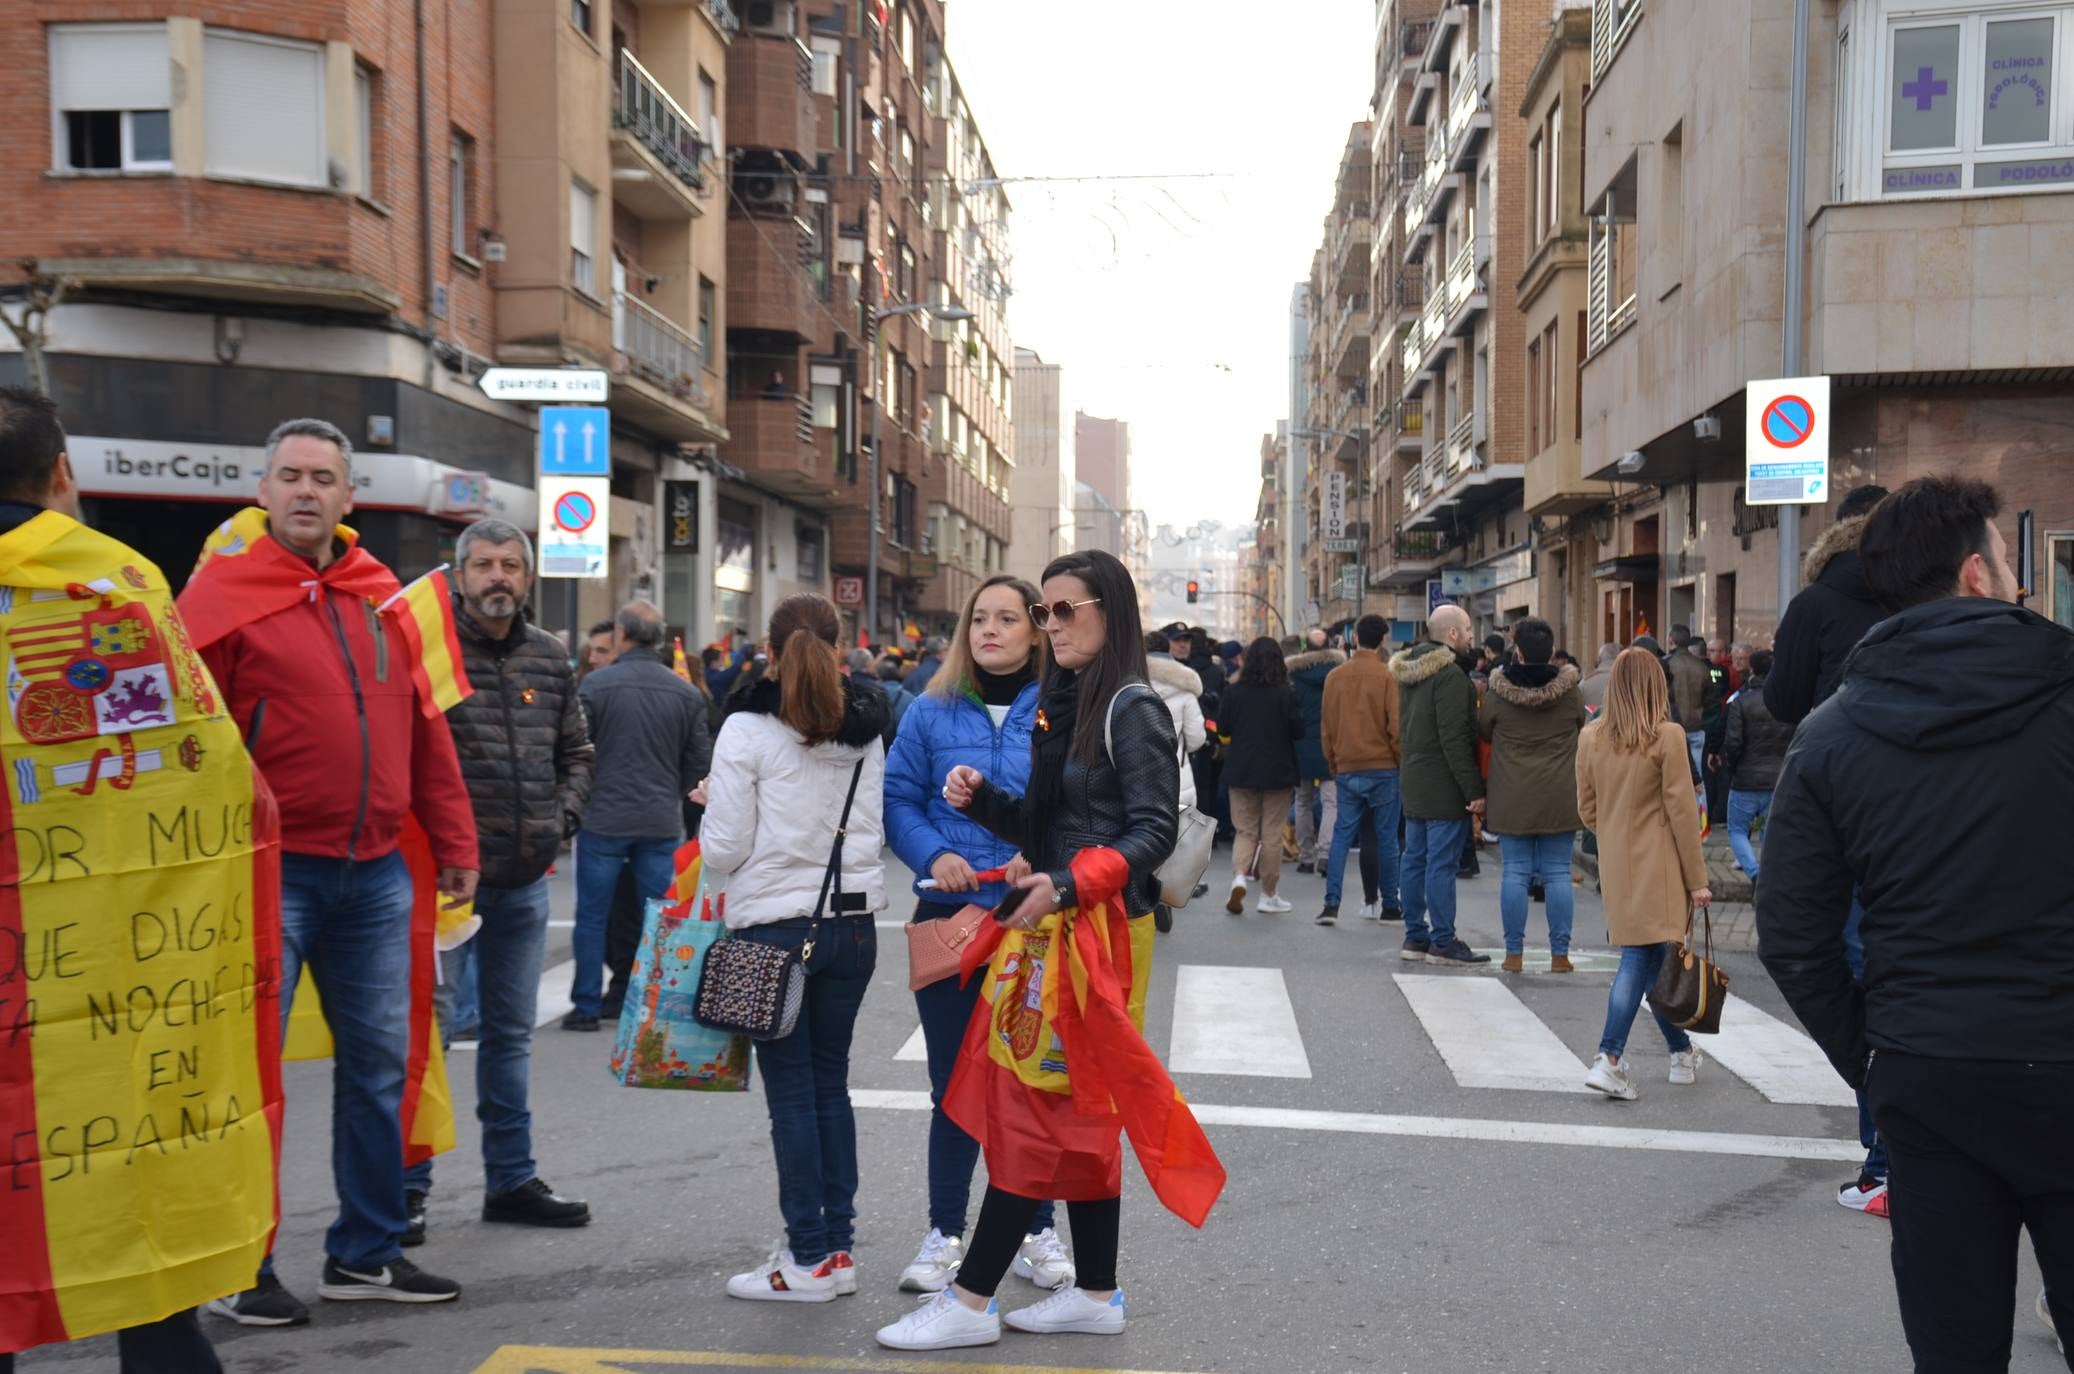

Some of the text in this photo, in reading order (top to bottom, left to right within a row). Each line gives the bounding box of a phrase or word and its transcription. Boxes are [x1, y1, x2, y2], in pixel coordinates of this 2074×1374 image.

[1992, 56, 2044, 70] CLÍNICA
[1989, 73, 2045, 110] PODOLÓGICA
[1887, 170, 1956, 188] CLÍNICA
[496, 377, 602, 392] guardia civil
[104, 449, 240, 486] iberCaja
[147, 1045, 199, 1091] EN
[11, 1091, 245, 1191] ESPAÑA
